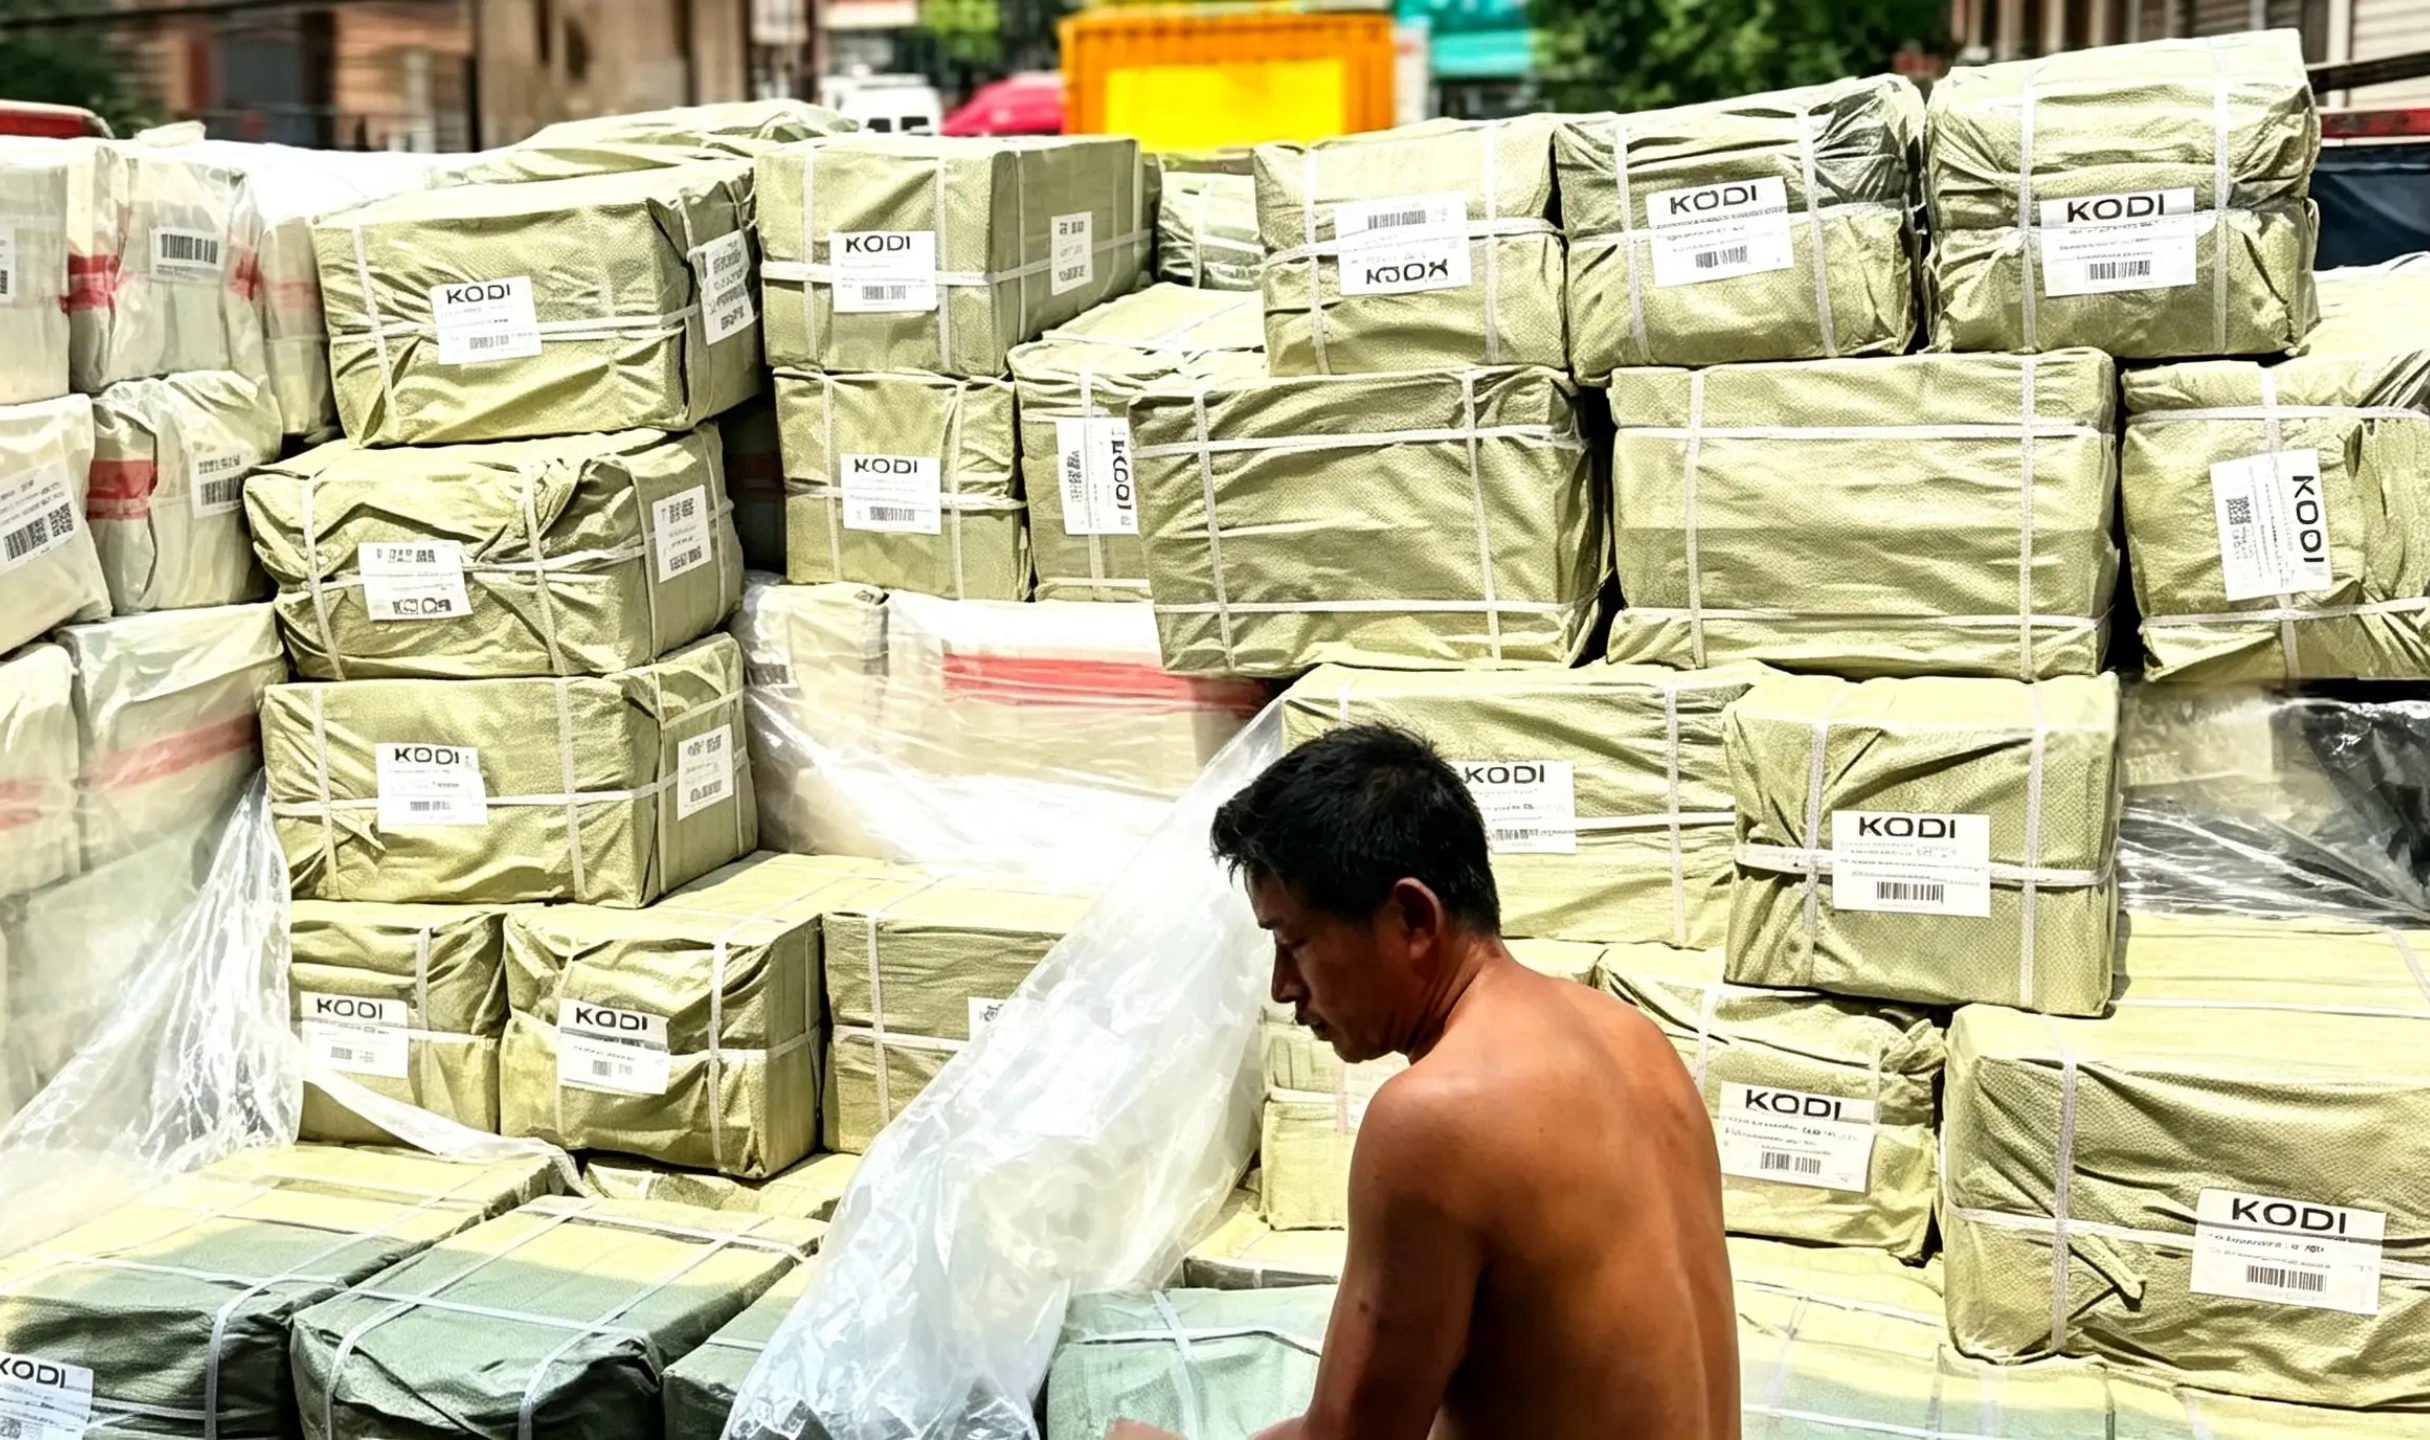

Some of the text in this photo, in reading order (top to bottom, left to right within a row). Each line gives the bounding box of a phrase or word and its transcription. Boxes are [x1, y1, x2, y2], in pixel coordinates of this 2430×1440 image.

[1670, 184, 1757, 215] KODI
[2067, 194, 2165, 223] KODI
[846, 235, 910, 253] KODI
[446, 284, 511, 304] KODI
[854, 458, 918, 474] KODI
[395, 747, 460, 765] KODI
[1464, 764, 1545, 784] KODI
[1859, 816, 1955, 839] KODI
[317, 998, 383, 1018] KODI
[576, 1007, 648, 1031] KODI
[1745, 1089, 1842, 1121] KODI
[2232, 1198, 2346, 1234] KODI
